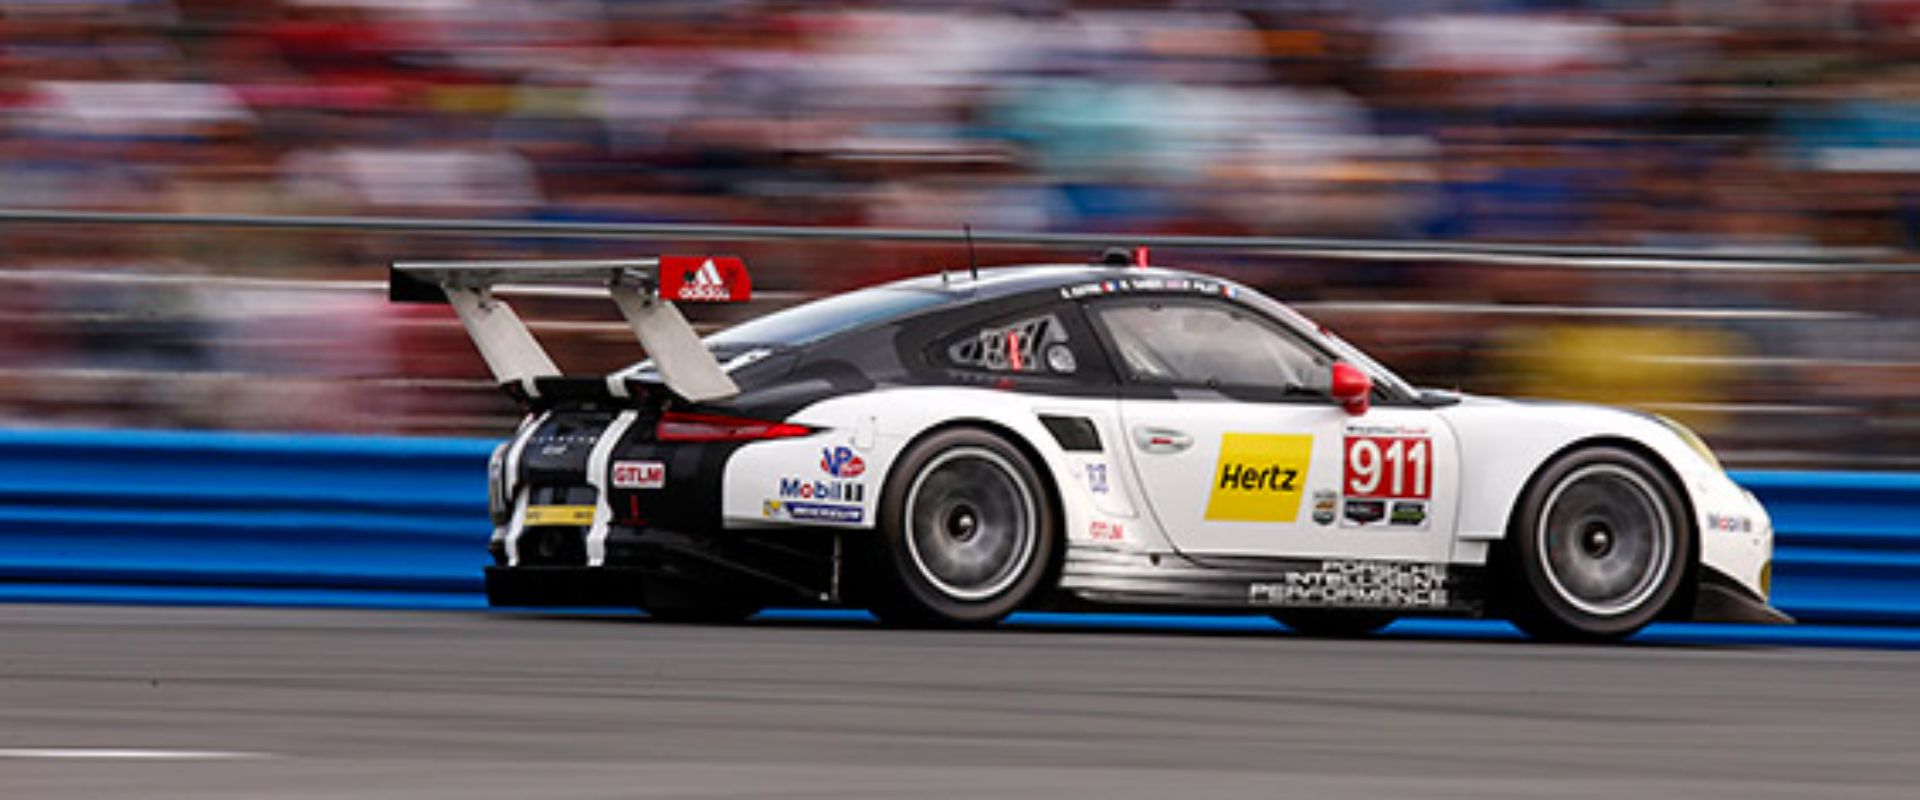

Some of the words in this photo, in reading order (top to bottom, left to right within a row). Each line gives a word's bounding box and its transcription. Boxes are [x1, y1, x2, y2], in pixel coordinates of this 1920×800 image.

[615, 466, 663, 483] GTLM
[823, 446, 853, 476] VP
[1349, 438, 1425, 496] 911
[779, 477, 841, 498] Mobil
[1220, 463, 1297, 491] Hertz
